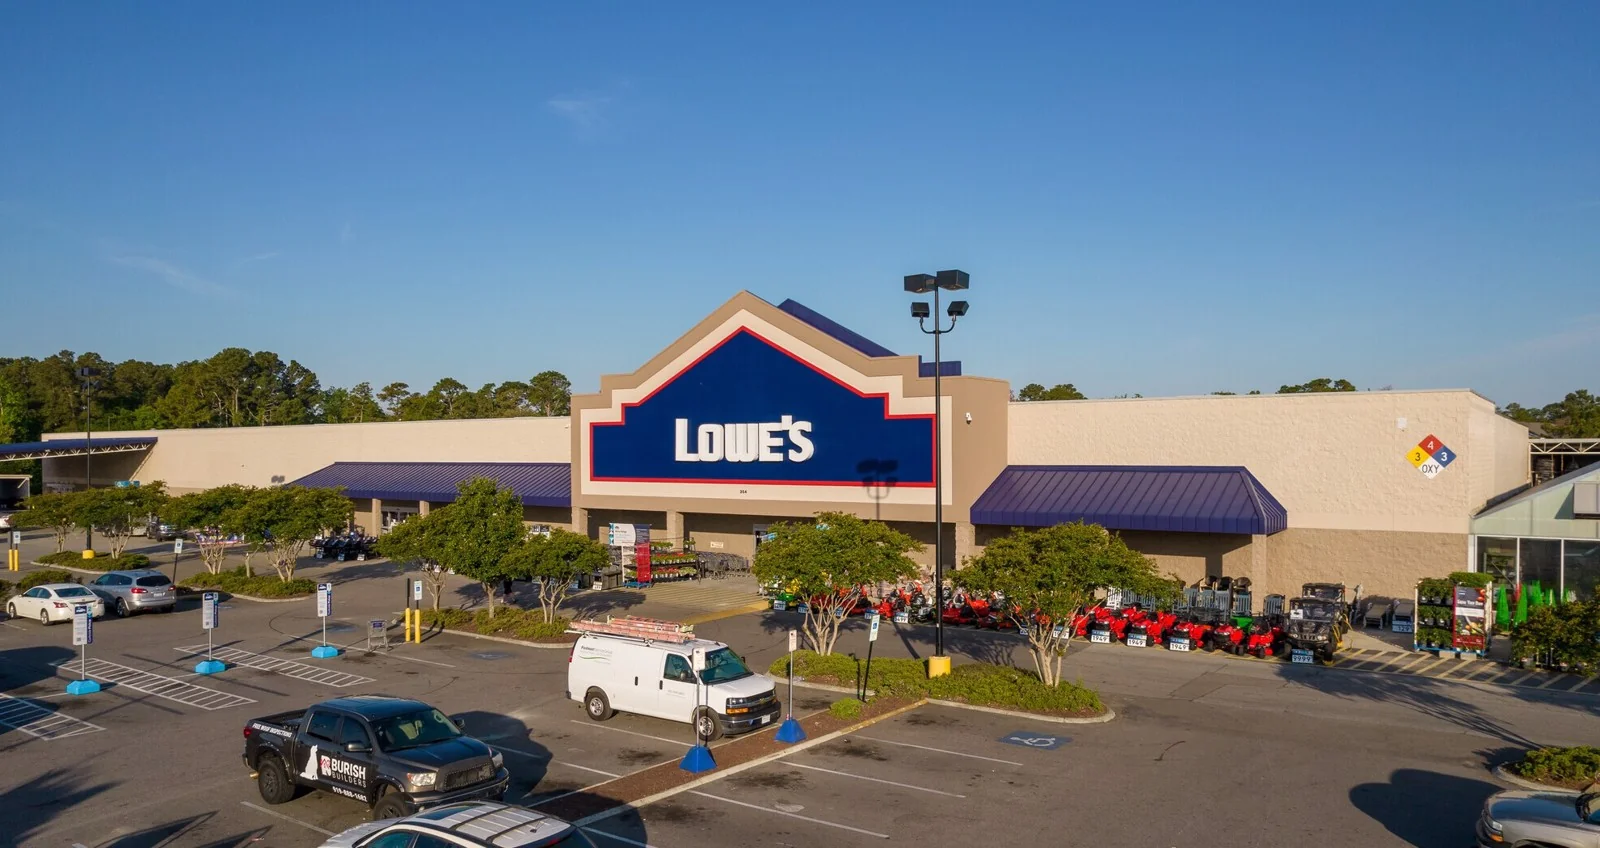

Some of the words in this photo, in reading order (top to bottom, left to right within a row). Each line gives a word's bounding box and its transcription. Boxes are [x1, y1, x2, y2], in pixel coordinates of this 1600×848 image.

[675, 414, 815, 463] LOWE'S
[1427, 440, 1434, 450] 4
[1415, 452, 1421, 461] 3
[1441, 452, 1448, 461] 3
[1422, 464, 1440, 473] OXY
[331, 758, 367, 780] BURISH
[332, 771, 367, 788] BUILDERS
